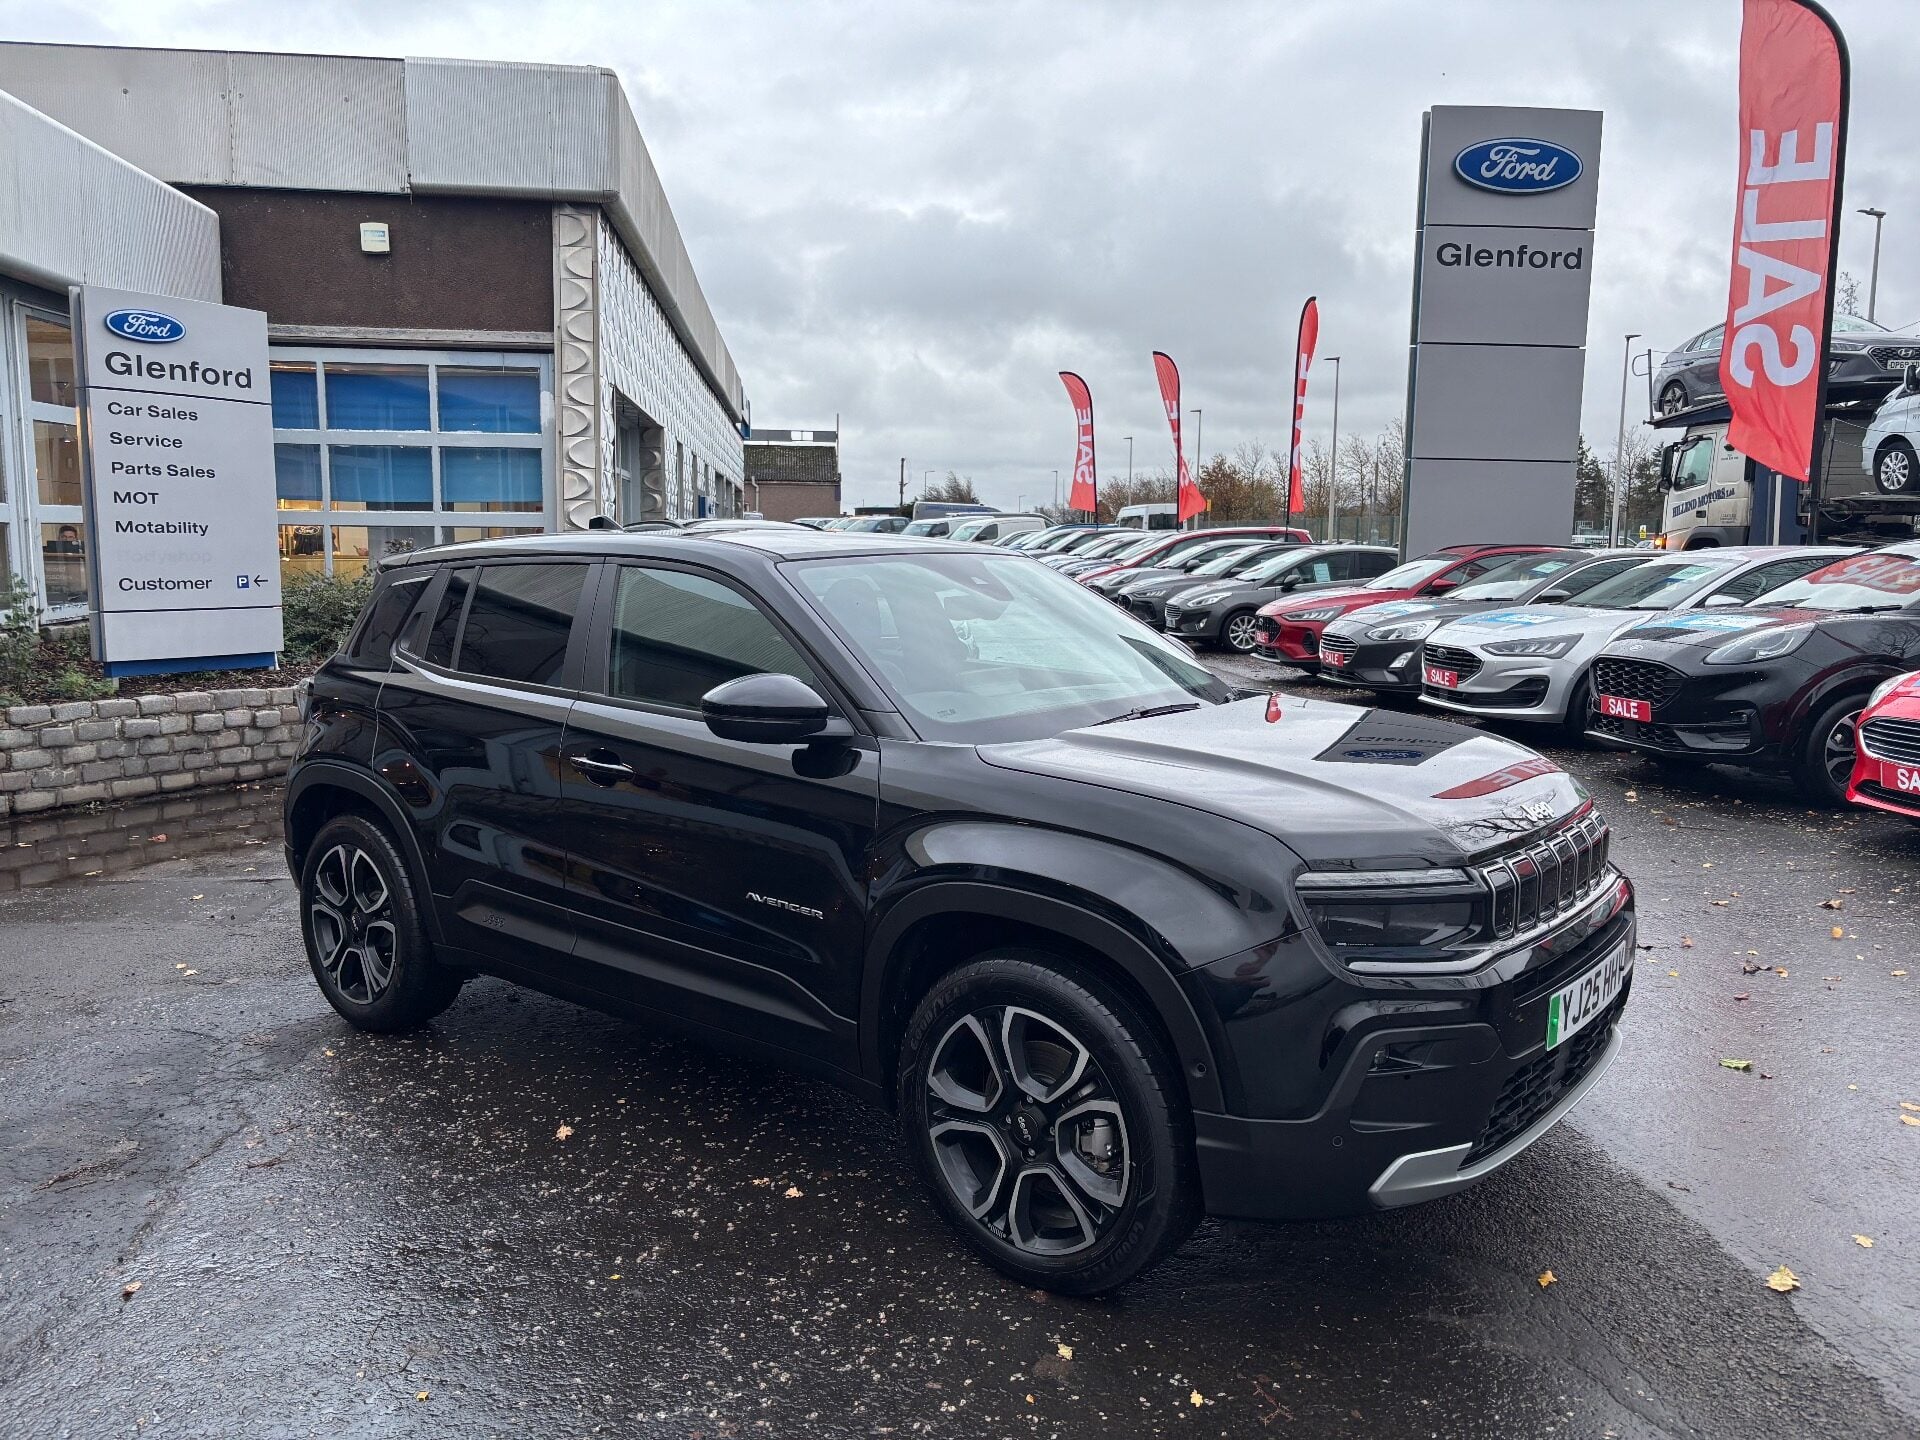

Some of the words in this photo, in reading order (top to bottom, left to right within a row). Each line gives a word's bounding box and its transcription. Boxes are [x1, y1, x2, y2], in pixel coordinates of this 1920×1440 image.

[1480, 145, 1559, 182] Ford
[1436, 242, 1583, 270] Glenford
[123, 313, 172, 338] Ford
[104, 351, 252, 390] Glenford
[107, 401, 143, 417] Car
[147, 404, 199, 421] Sales
[109, 431, 183, 449] Service
[111, 461, 162, 477] Parts
[166, 463, 216, 479] Sales
[113, 490, 159, 505] MOT
[1671, 498, 1698, 519] HILLEND
[1697, 486, 1726, 508] MOTORS
[115, 519, 209, 537] Motability
[118, 575, 213, 592] Customer
[1324, 653, 1340, 665] SALE
[1430, 669, 1451, 685] SALE
[1608, 698, 1639, 719] SALE
[1520, 801, 1555, 823] Jeep
[745, 891, 824, 920] AVENGER
[1563, 968, 1602, 1032] YJ25
